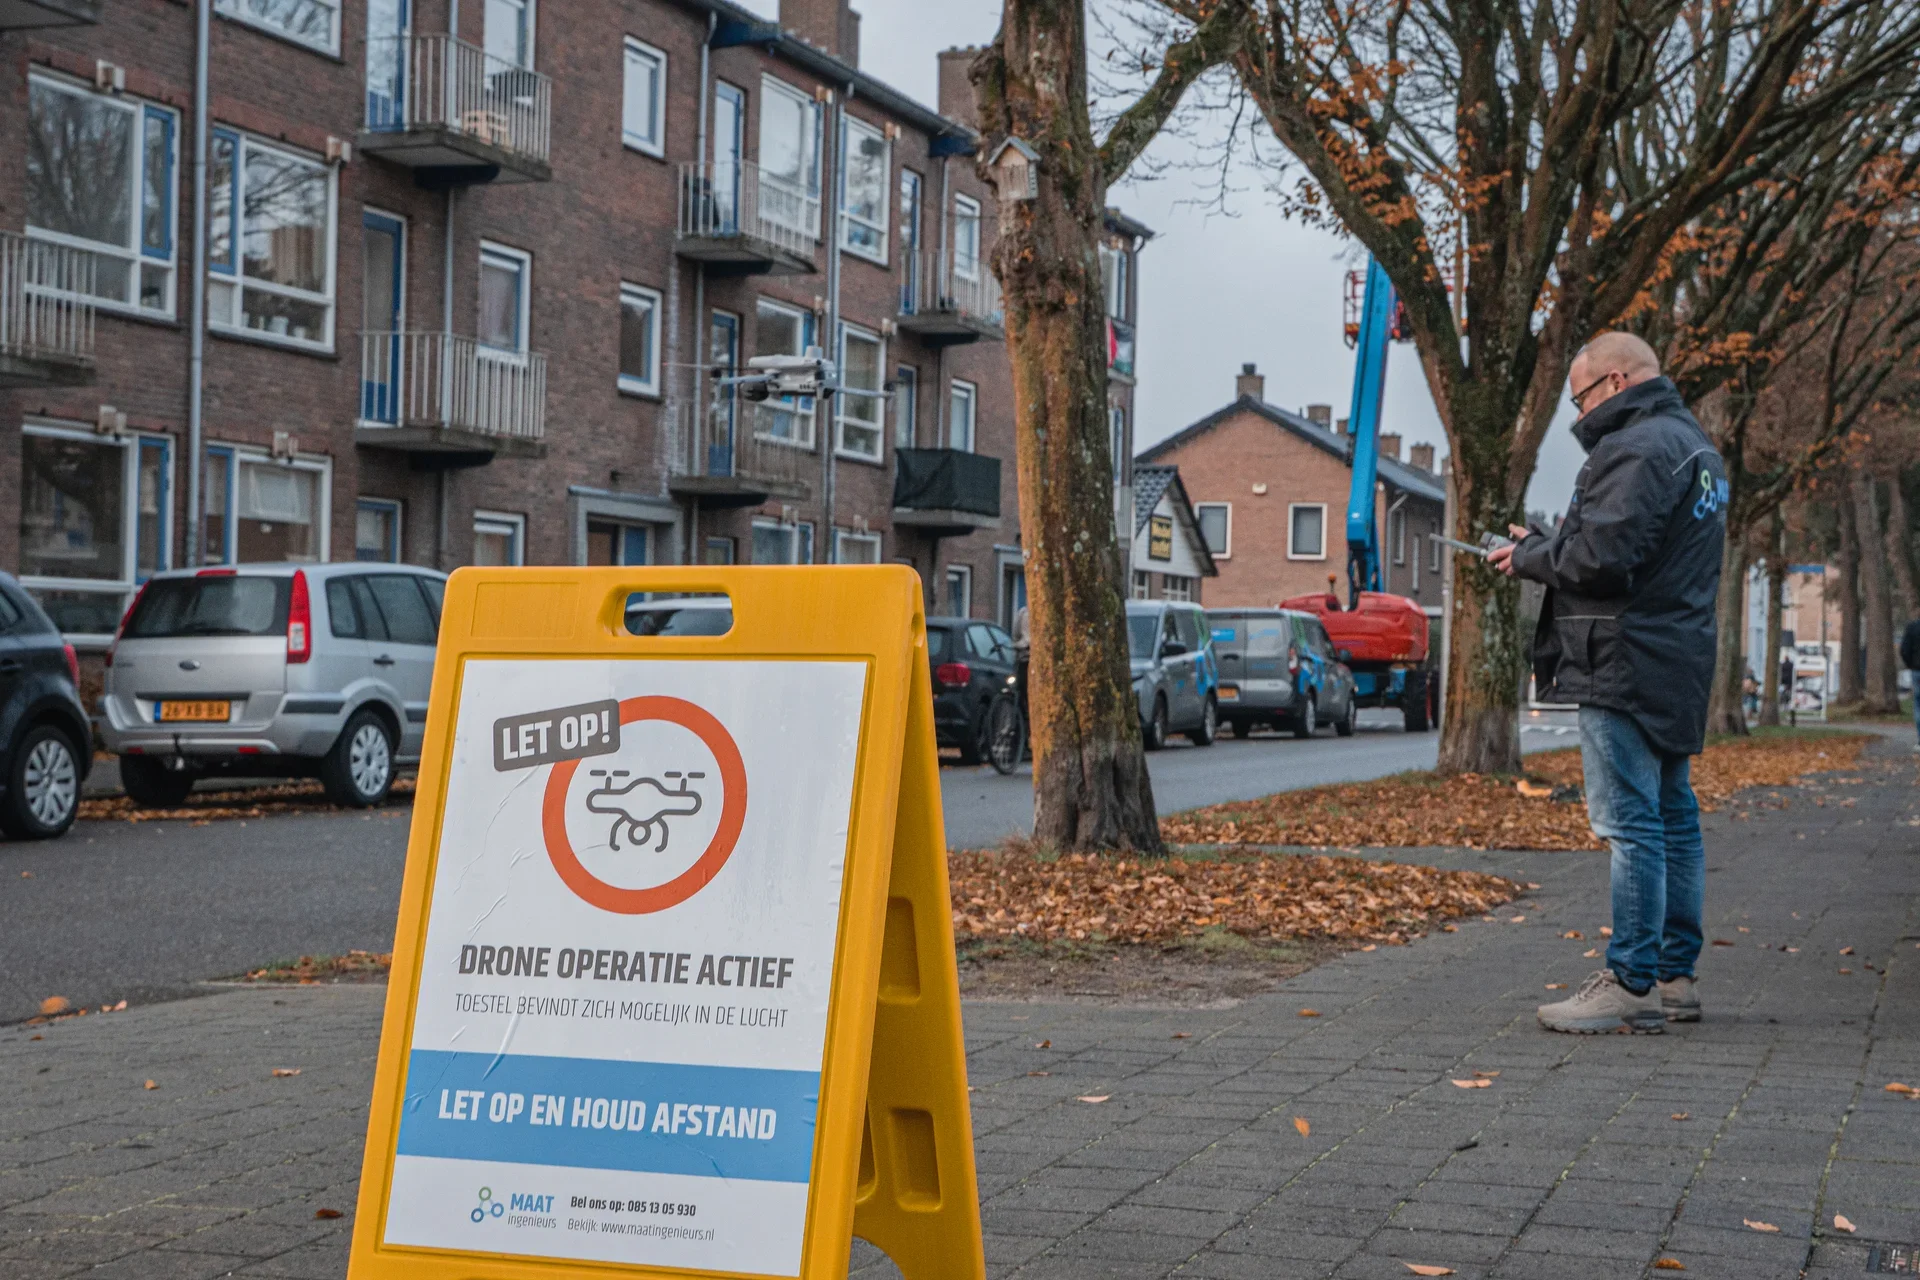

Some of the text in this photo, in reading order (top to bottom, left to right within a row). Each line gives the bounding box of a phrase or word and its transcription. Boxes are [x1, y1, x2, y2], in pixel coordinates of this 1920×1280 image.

[503, 711, 609, 760] LET OP!
[459, 944, 794, 988] DRONE OPERATIE ACTIEF
[455, 993, 788, 1027] TOESTEL BEVINDT ZICH MOGELIJK IN DE LUCHT
[439, 1089, 776, 1139] LET OP EN HOUD AFSTAND
[510, 1193, 555, 1212] MAAT
[571, 1196, 697, 1216] Bel ons op: 085 13 05 930
[507, 1214, 557, 1229] ingenieurs
[567, 1218, 715, 1241] Bekijk: www.maatingenieurs.nl
